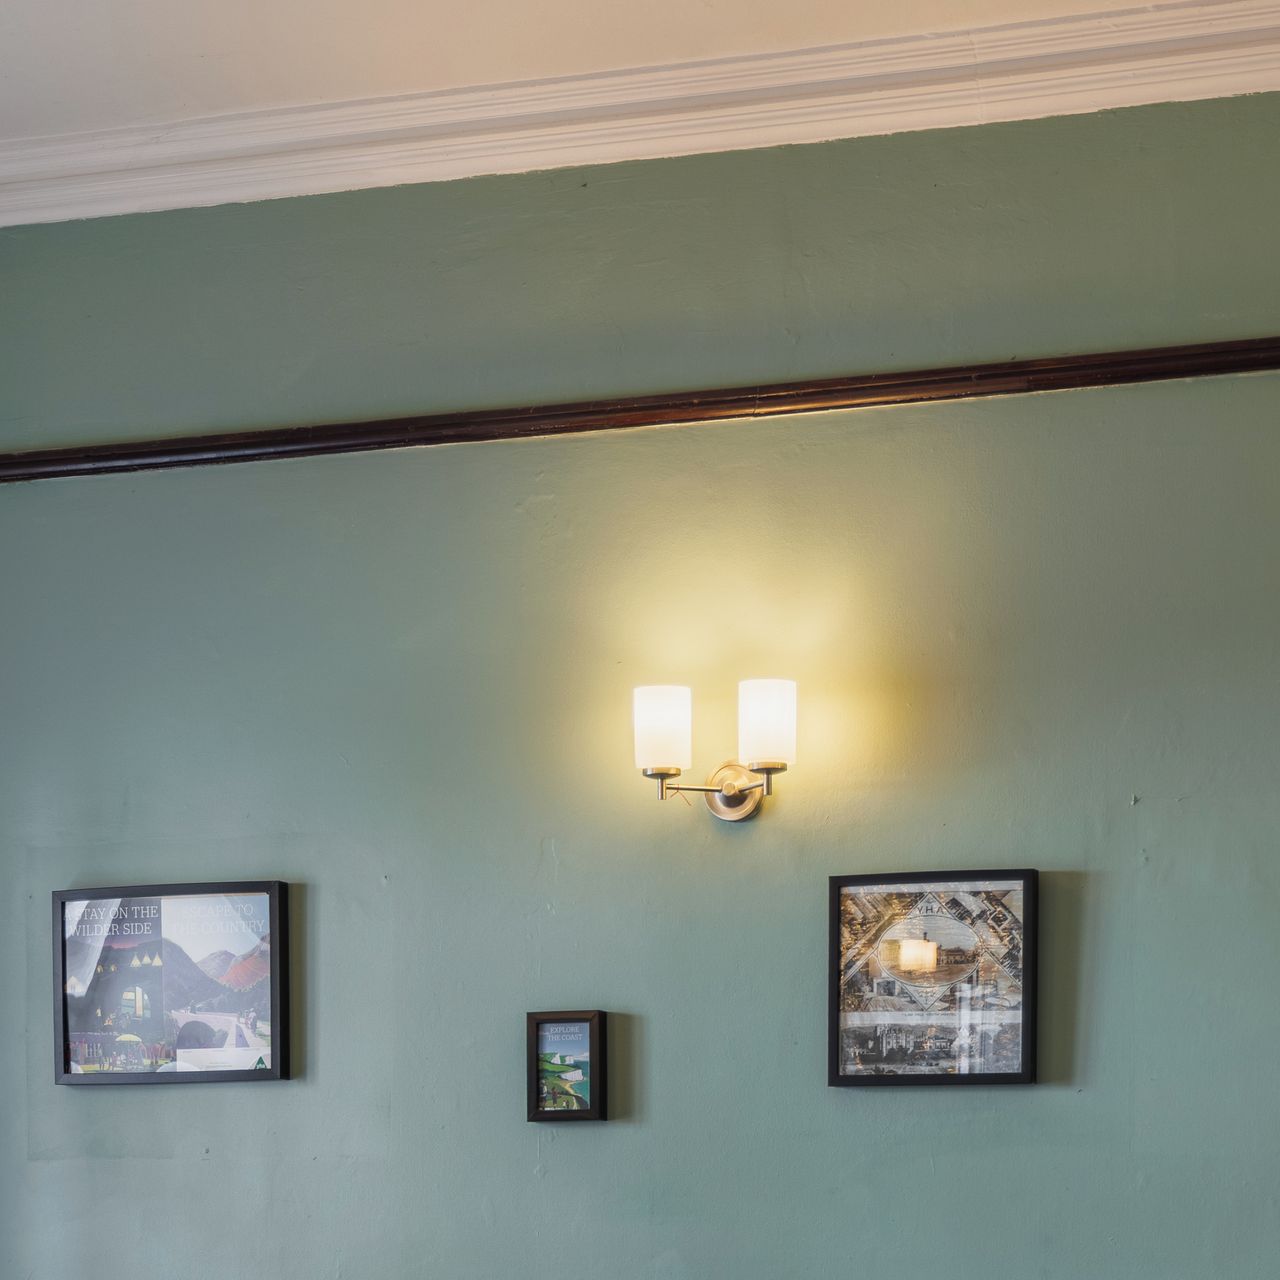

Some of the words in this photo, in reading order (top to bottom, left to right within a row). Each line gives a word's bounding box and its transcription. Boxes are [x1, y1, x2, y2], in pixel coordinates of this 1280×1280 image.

[110, 907, 129, 920] ON
[131, 905, 159, 919] THE
[122, 921, 153, 936] SIDE
[550, 1026, 580, 1034] EXPLORE
[561, 1033, 583, 1041] COAST
